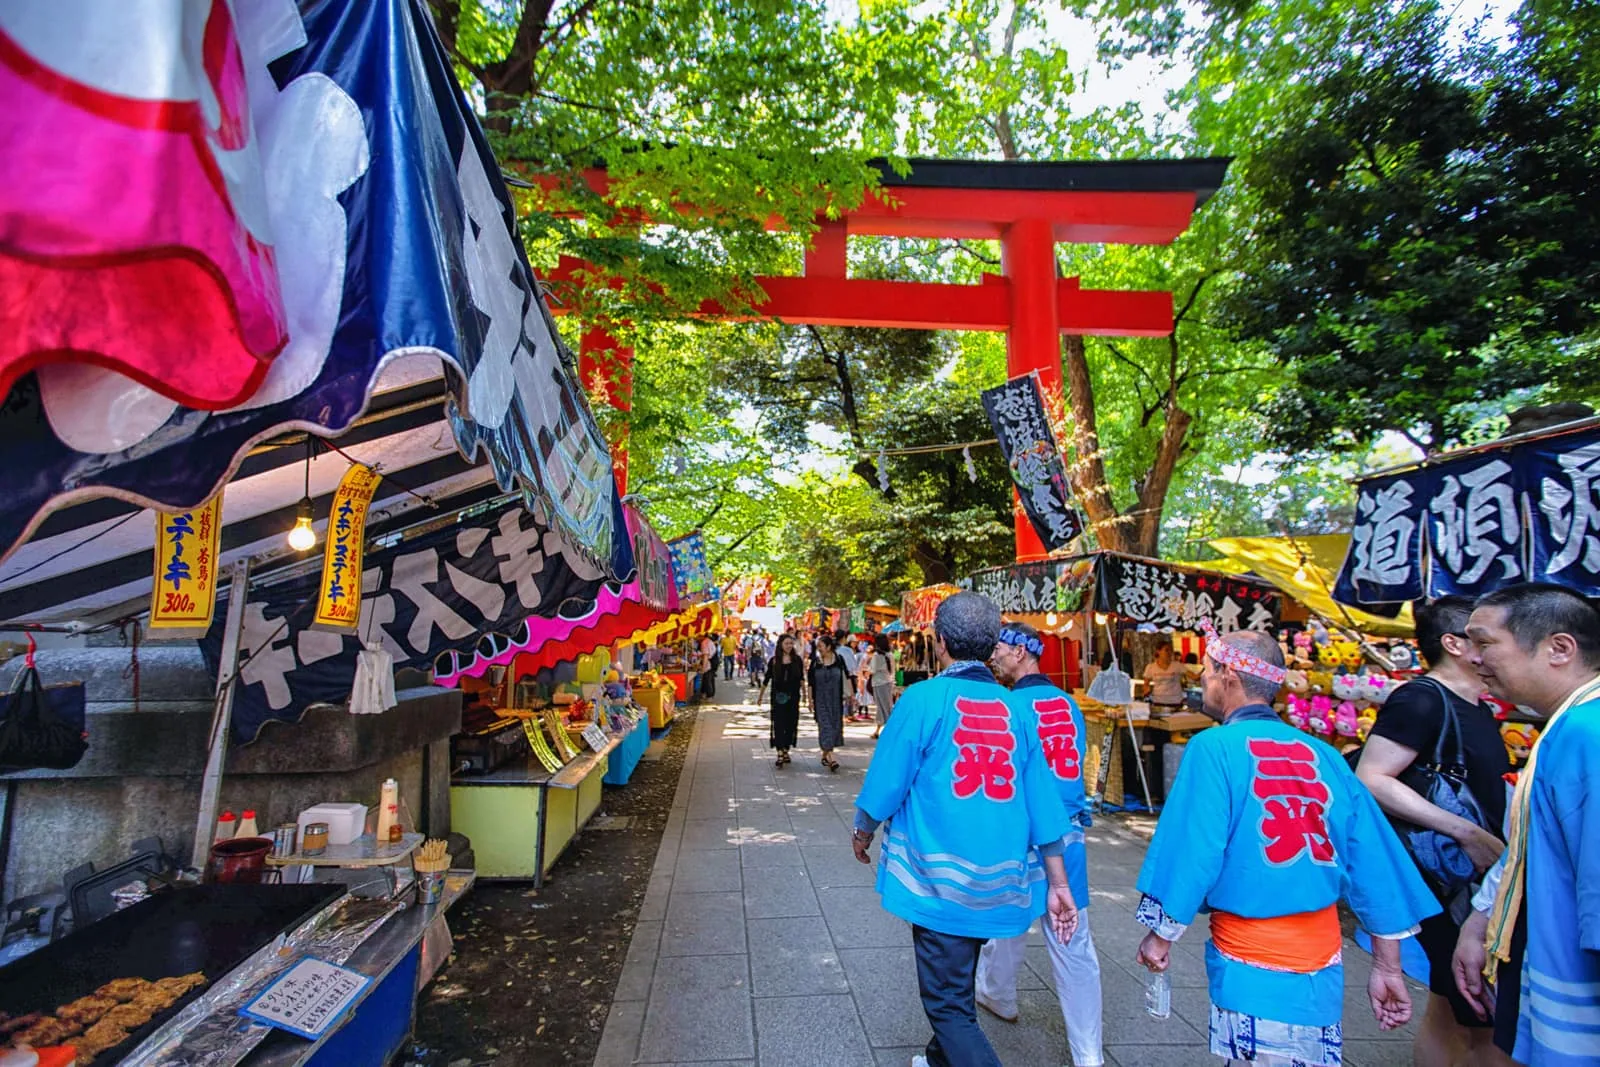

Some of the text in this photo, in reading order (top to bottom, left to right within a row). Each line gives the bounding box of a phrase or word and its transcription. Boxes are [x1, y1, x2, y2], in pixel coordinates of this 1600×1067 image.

[163, 513, 194, 591] テーキ
[328, 500, 353, 603] チキンステーキ
[953, 696, 1016, 801] 三光
[1033, 696, 1080, 780] 三光
